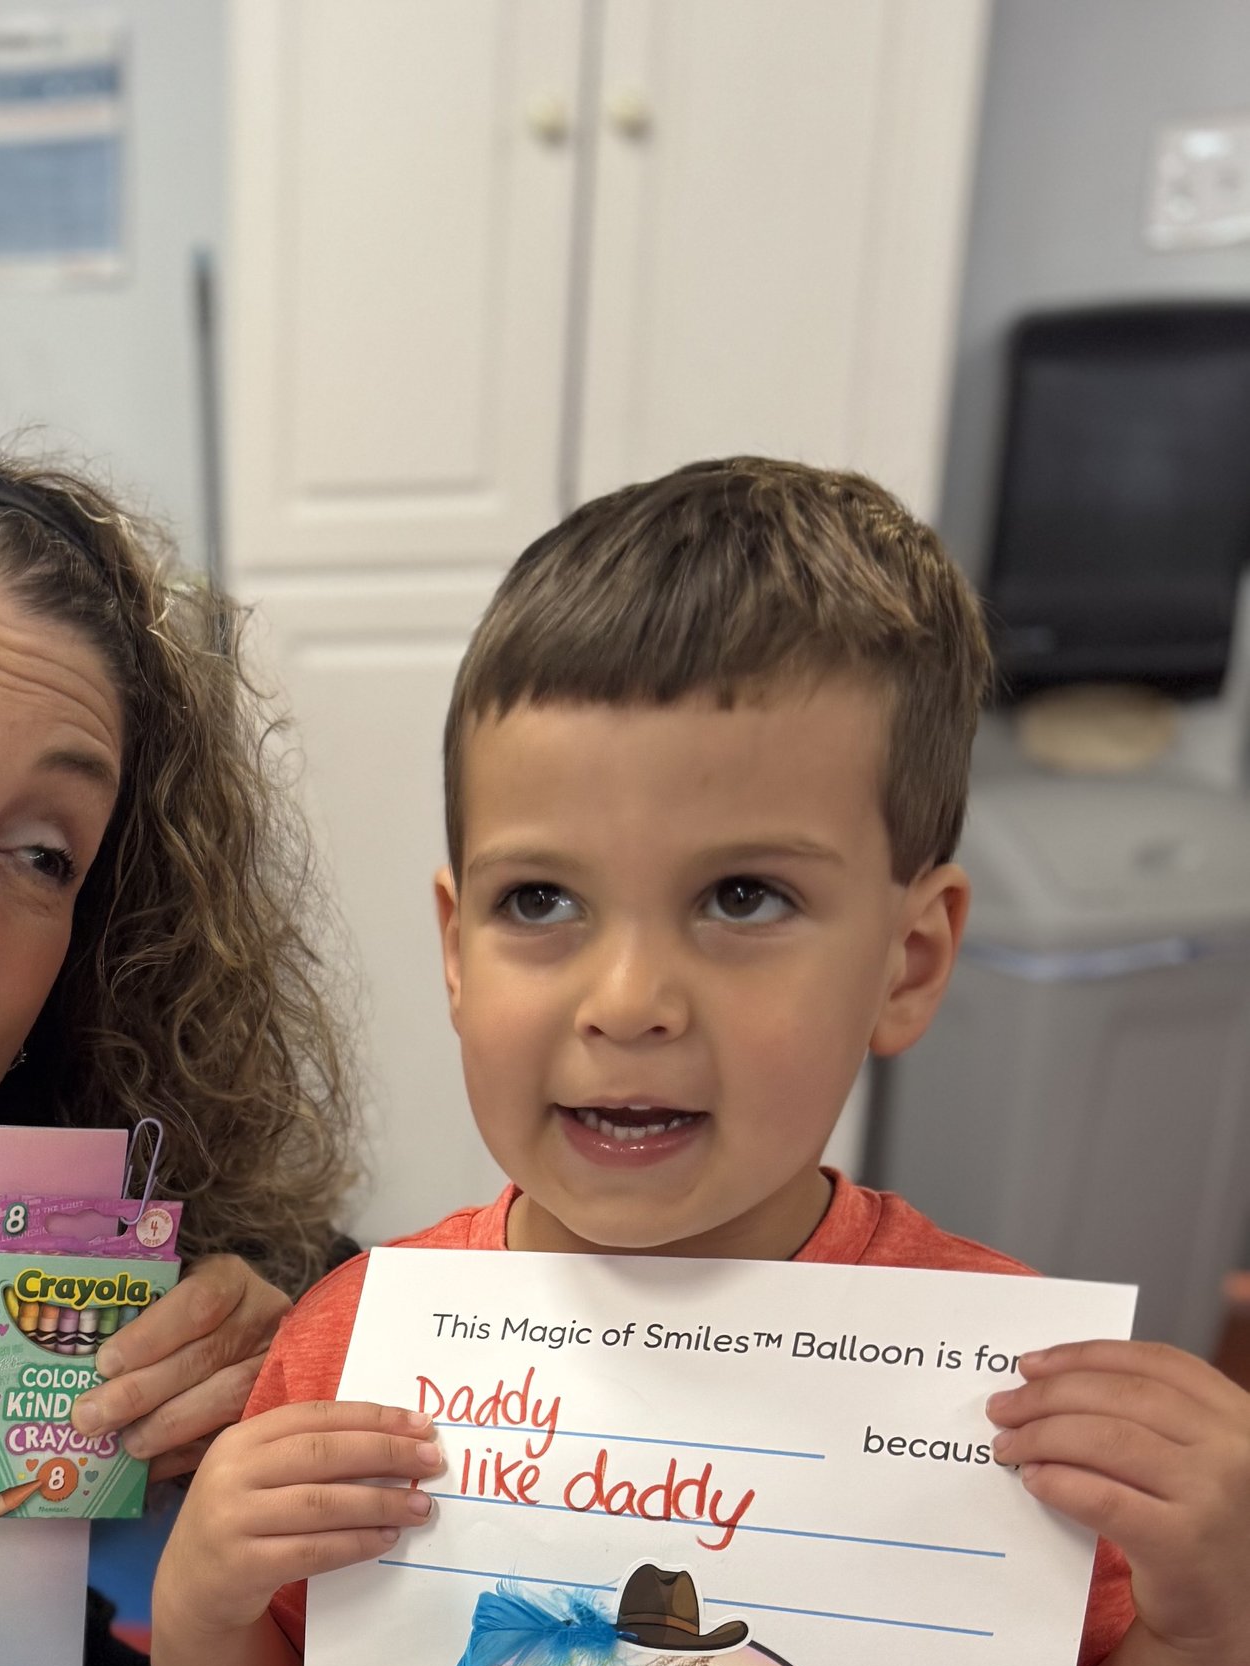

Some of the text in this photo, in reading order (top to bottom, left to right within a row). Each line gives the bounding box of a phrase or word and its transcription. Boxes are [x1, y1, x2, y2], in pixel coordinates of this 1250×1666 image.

[5, 1204, 26, 1234] 8
[150, 1220, 159, 1237] 4
[15, 1269, 149, 1308] Crayola
[433, 1313, 491, 1340] This
[500, 1317, 593, 1350] Magic
[601, 1322, 637, 1348] of
[791, 1331, 924, 1367] Balloon
[936, 1341, 963, 1370] is
[975, 1344, 1021, 1374] for
[22, 1368, 104, 1389] COLORS
[415, 1366, 562, 1460] Daddy
[8, 1426, 119, 1455] CRAYONS
[48, 1466, 65, 1490] 8
[461, 1448, 756, 1551] like daddy
